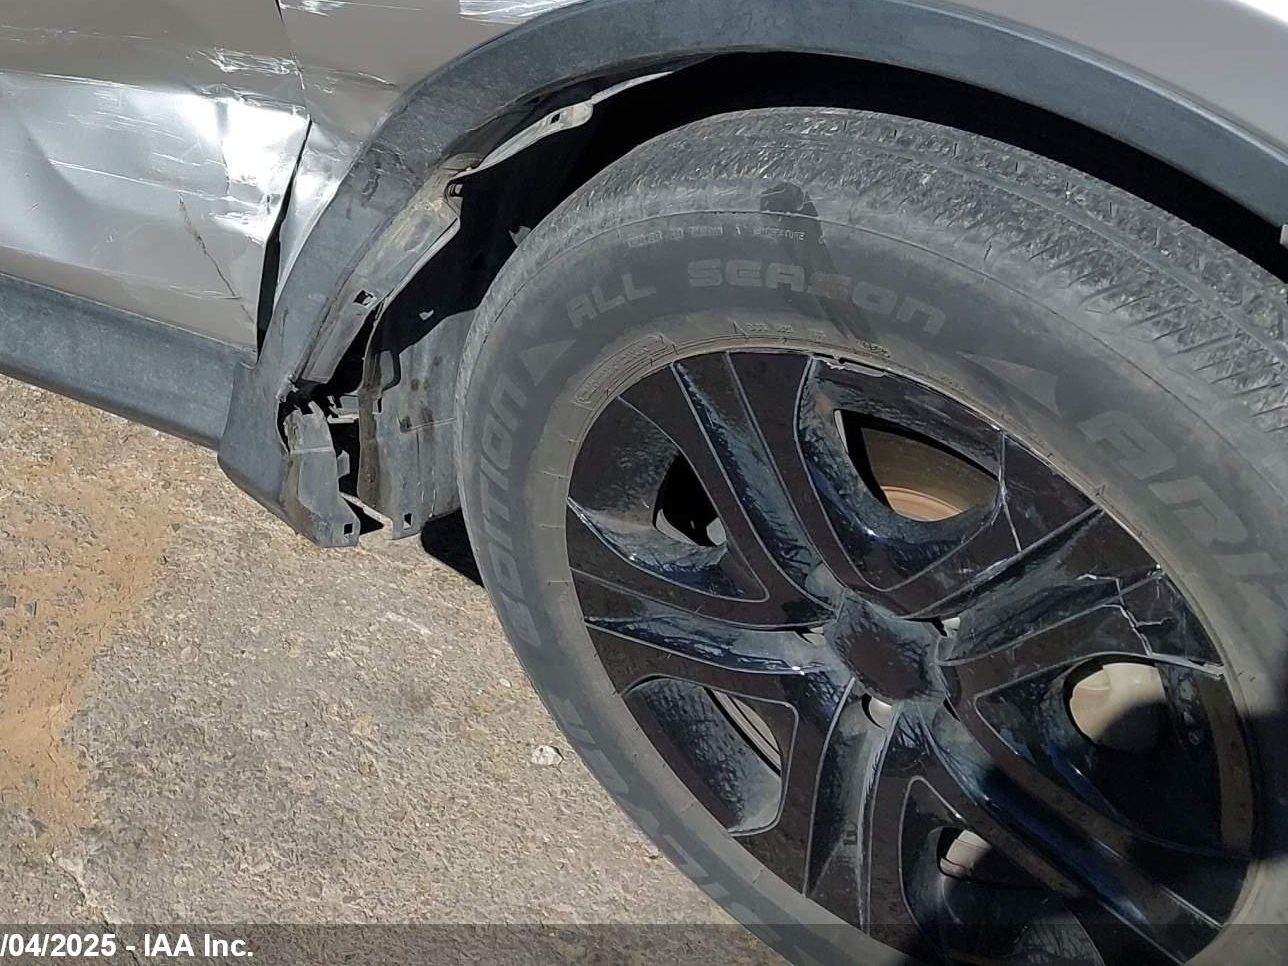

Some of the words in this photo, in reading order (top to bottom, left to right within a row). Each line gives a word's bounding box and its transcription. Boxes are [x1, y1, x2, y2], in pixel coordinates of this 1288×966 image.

[567, 272, 659, 330] ALL
[687, 258, 947, 335] SEASON
[478, 382, 541, 649] EDITION
